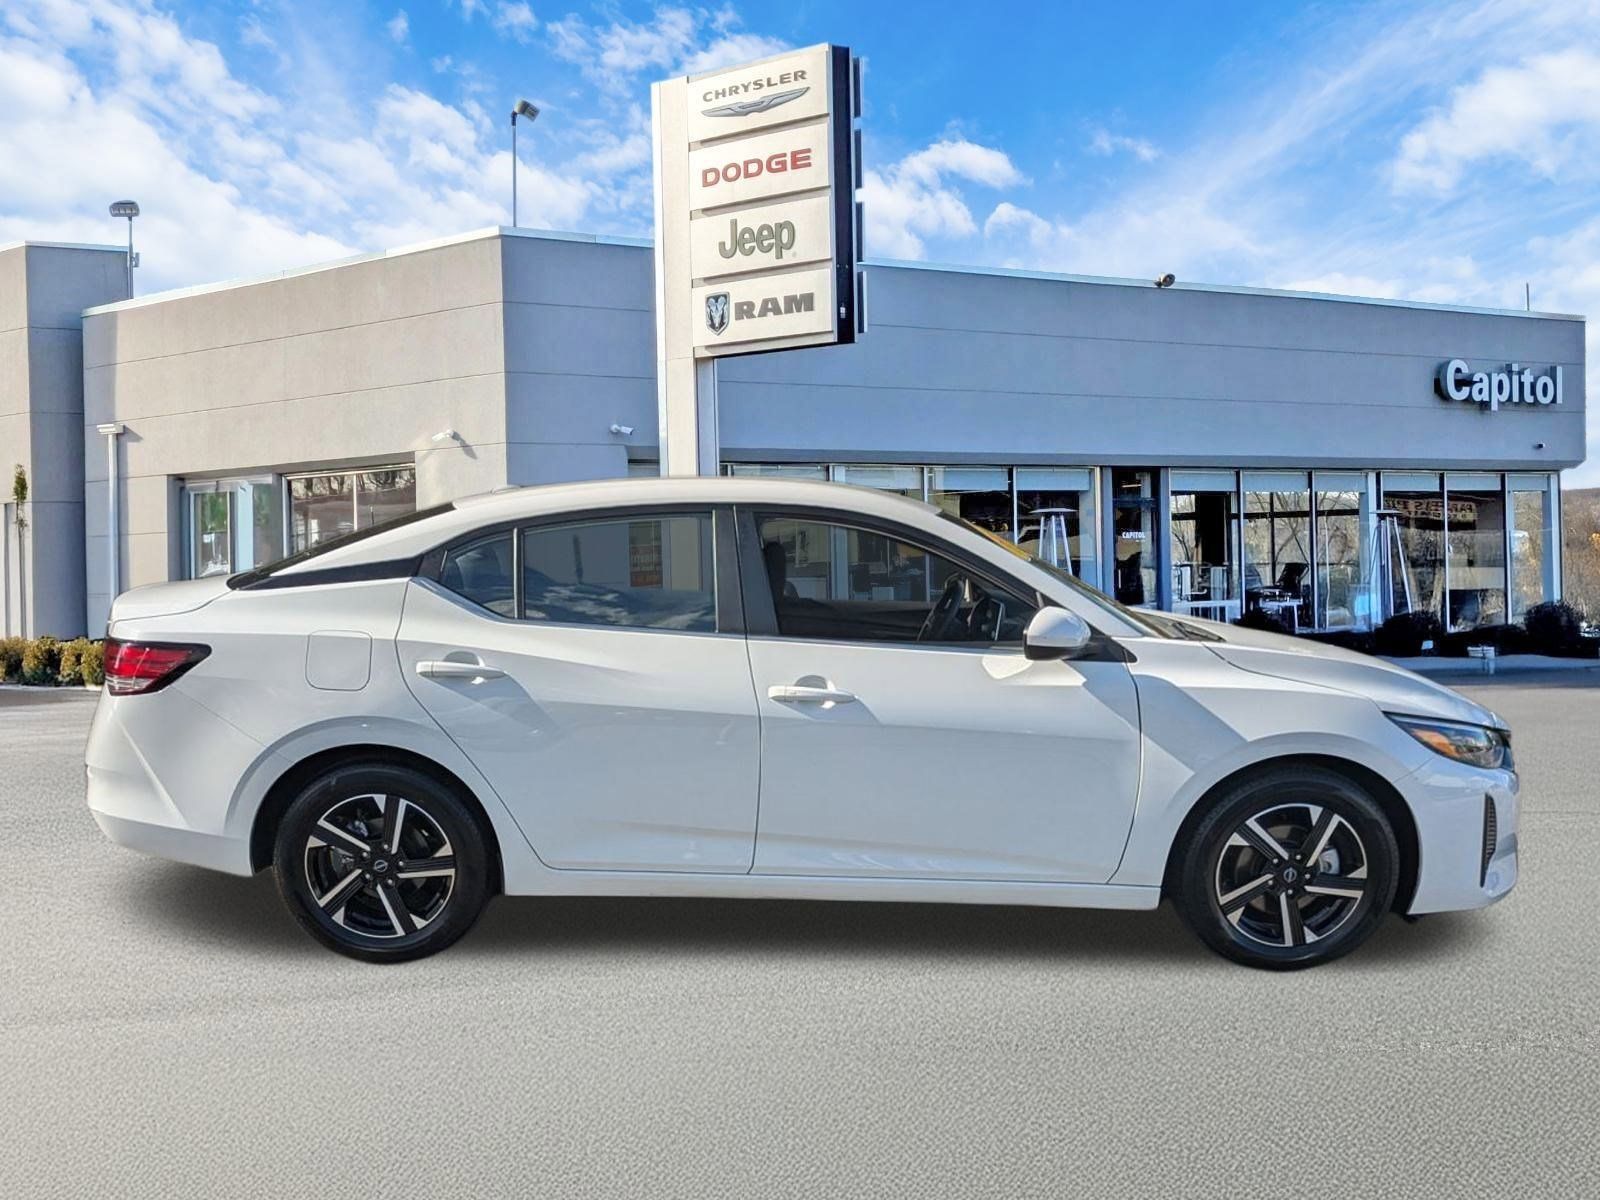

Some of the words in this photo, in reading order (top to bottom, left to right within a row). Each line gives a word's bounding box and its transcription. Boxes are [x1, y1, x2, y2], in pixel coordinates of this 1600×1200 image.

[702, 70, 807, 102] CHRYSLER
[702, 147, 812, 188] DODGE
[718, 218, 796, 260] Jeep
[735, 292, 814, 321] RAM
[1446, 358, 1563, 411] Capitol
[1122, 531, 1145, 539] CAPITOL
